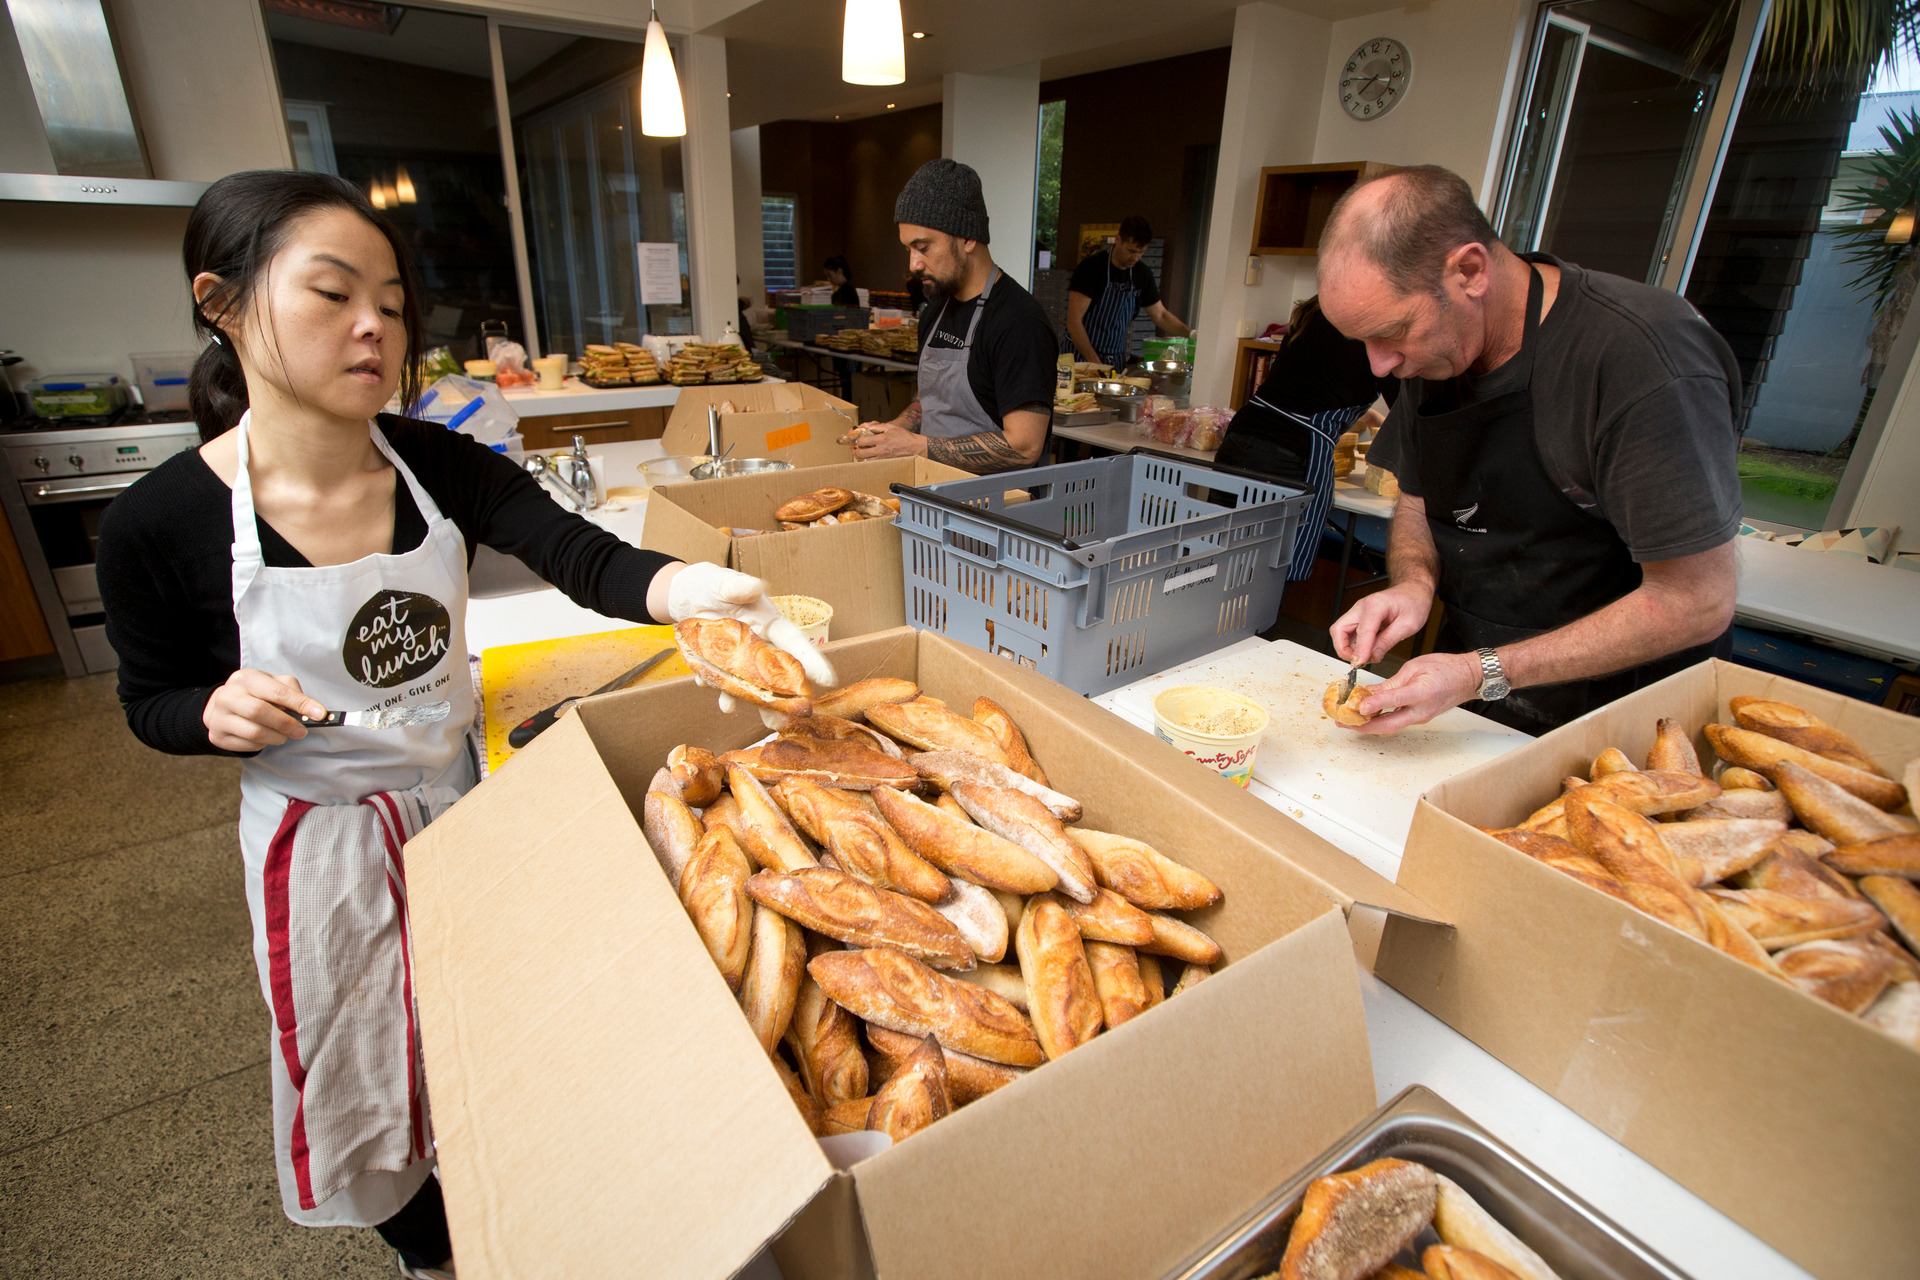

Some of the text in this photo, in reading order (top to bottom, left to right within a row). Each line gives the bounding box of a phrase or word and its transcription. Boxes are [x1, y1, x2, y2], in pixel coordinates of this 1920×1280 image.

[1370, 42, 1380, 53] 12
[1385, 44, 1391, 54] 1
[1357, 48, 1366, 59] 11
[1390, 54, 1400, 64] 2
[1346, 61, 1357, 73] 10
[1392, 70, 1402, 78] 3
[1387, 87, 1396, 95] 4
[1343, 93, 1352, 103] 8
[1376, 98, 1384, 108] 5
[1351, 102, 1359, 112] 7
[1363, 104, 1370, 115] 6
[356, 596, 412, 642] eat
[370, 625, 427, 655] my
[360, 624, 449, 685] lunch
[365, 703, 381, 712] UY
[409, 683, 432, 697] GIVE
[435, 673, 451, 688] ONE
[1184, 750, 1233, 770] untry
